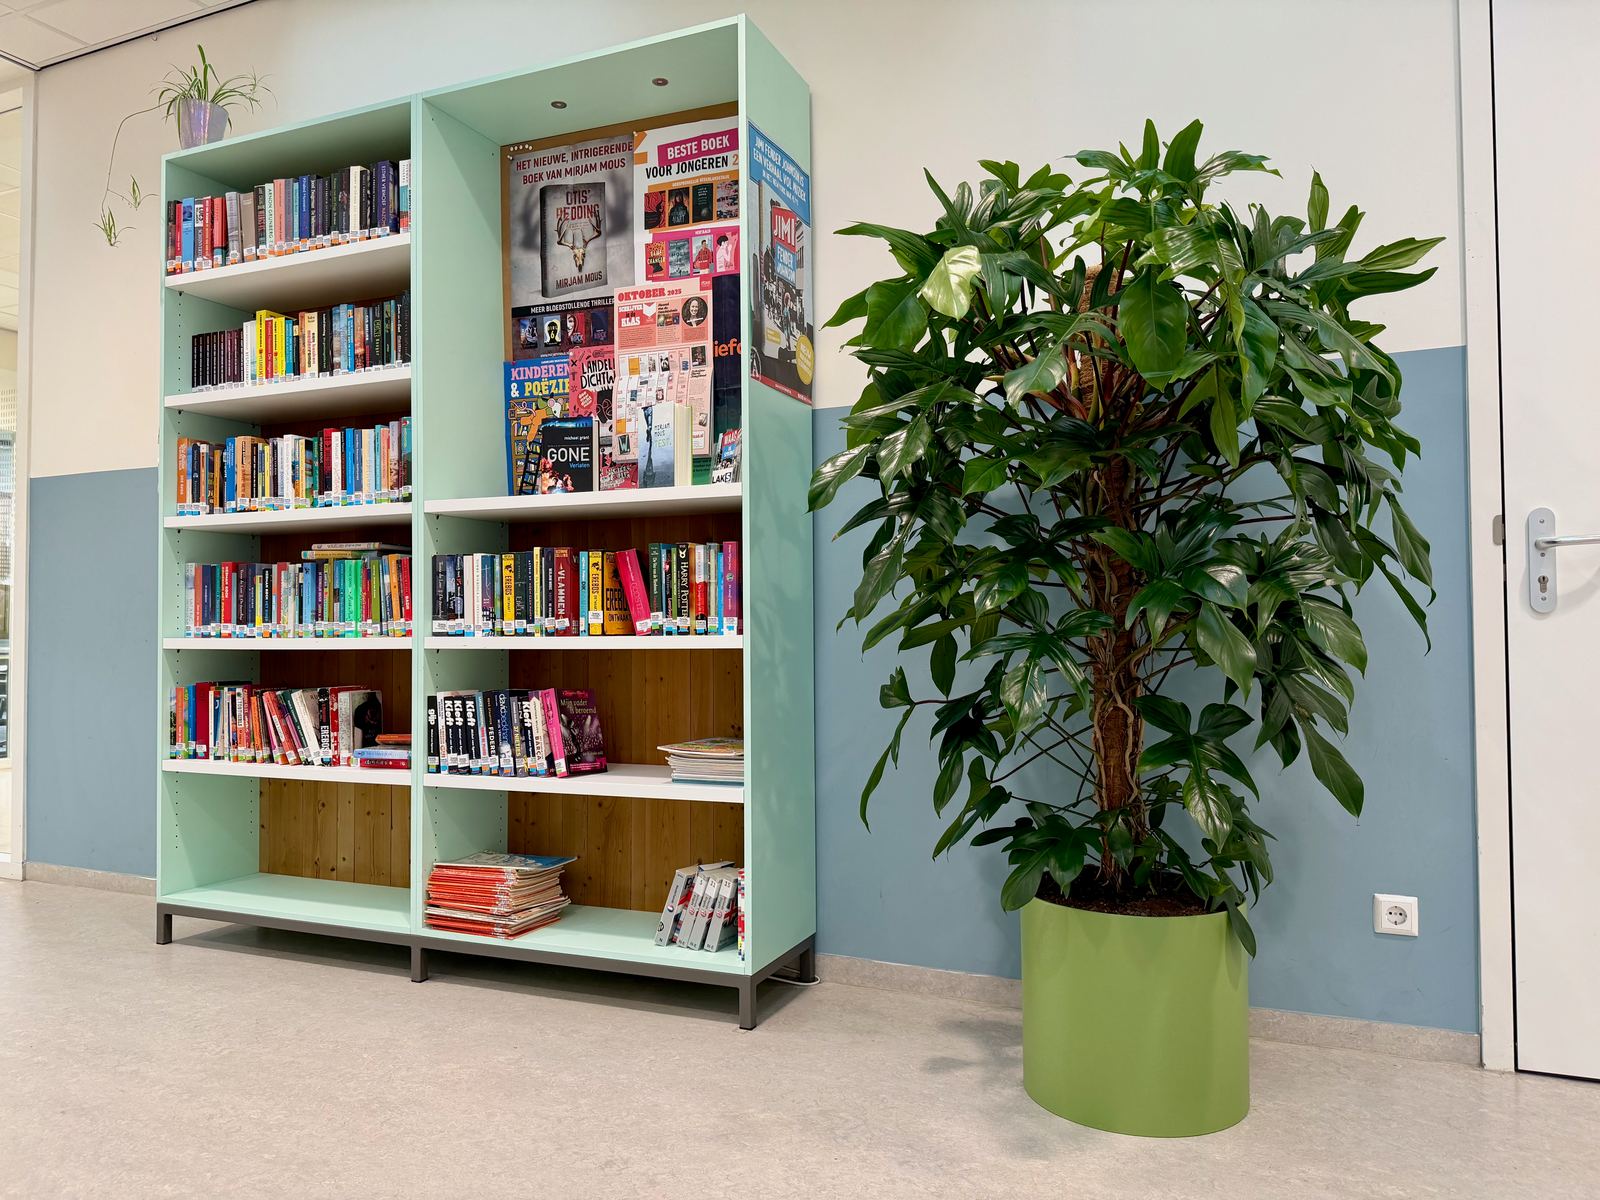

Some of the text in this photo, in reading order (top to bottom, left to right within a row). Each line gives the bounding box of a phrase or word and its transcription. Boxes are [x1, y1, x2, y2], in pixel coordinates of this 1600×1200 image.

[516, 142, 633, 171] HET NIEUWE, INTRIGERENDE
[667, 134, 730, 160] BESTE BOEK
[522, 158, 626, 184] BOEK VAN MIRJAM MOUS
[646, 164, 672, 179] VOOR
[676, 155, 728, 174] JONGEREN
[774, 215, 795, 247] JIMI
[556, 271, 603, 290] MIRJAM MOUS
[546, 300, 591, 312] BLOEDSTOLLENDE
[618, 288, 666, 302] OKTOBER
[621, 316, 640, 327] KLAS
[510, 382, 520, 398] &
[547, 447, 590, 462] GONE
[428, 709, 436, 725] gijp
[445, 700, 453, 726] Kieft
[454, 700, 463, 726] Kieft
[466, 700, 476, 726] Kieft
[522, 701, 531, 728] Kieft
